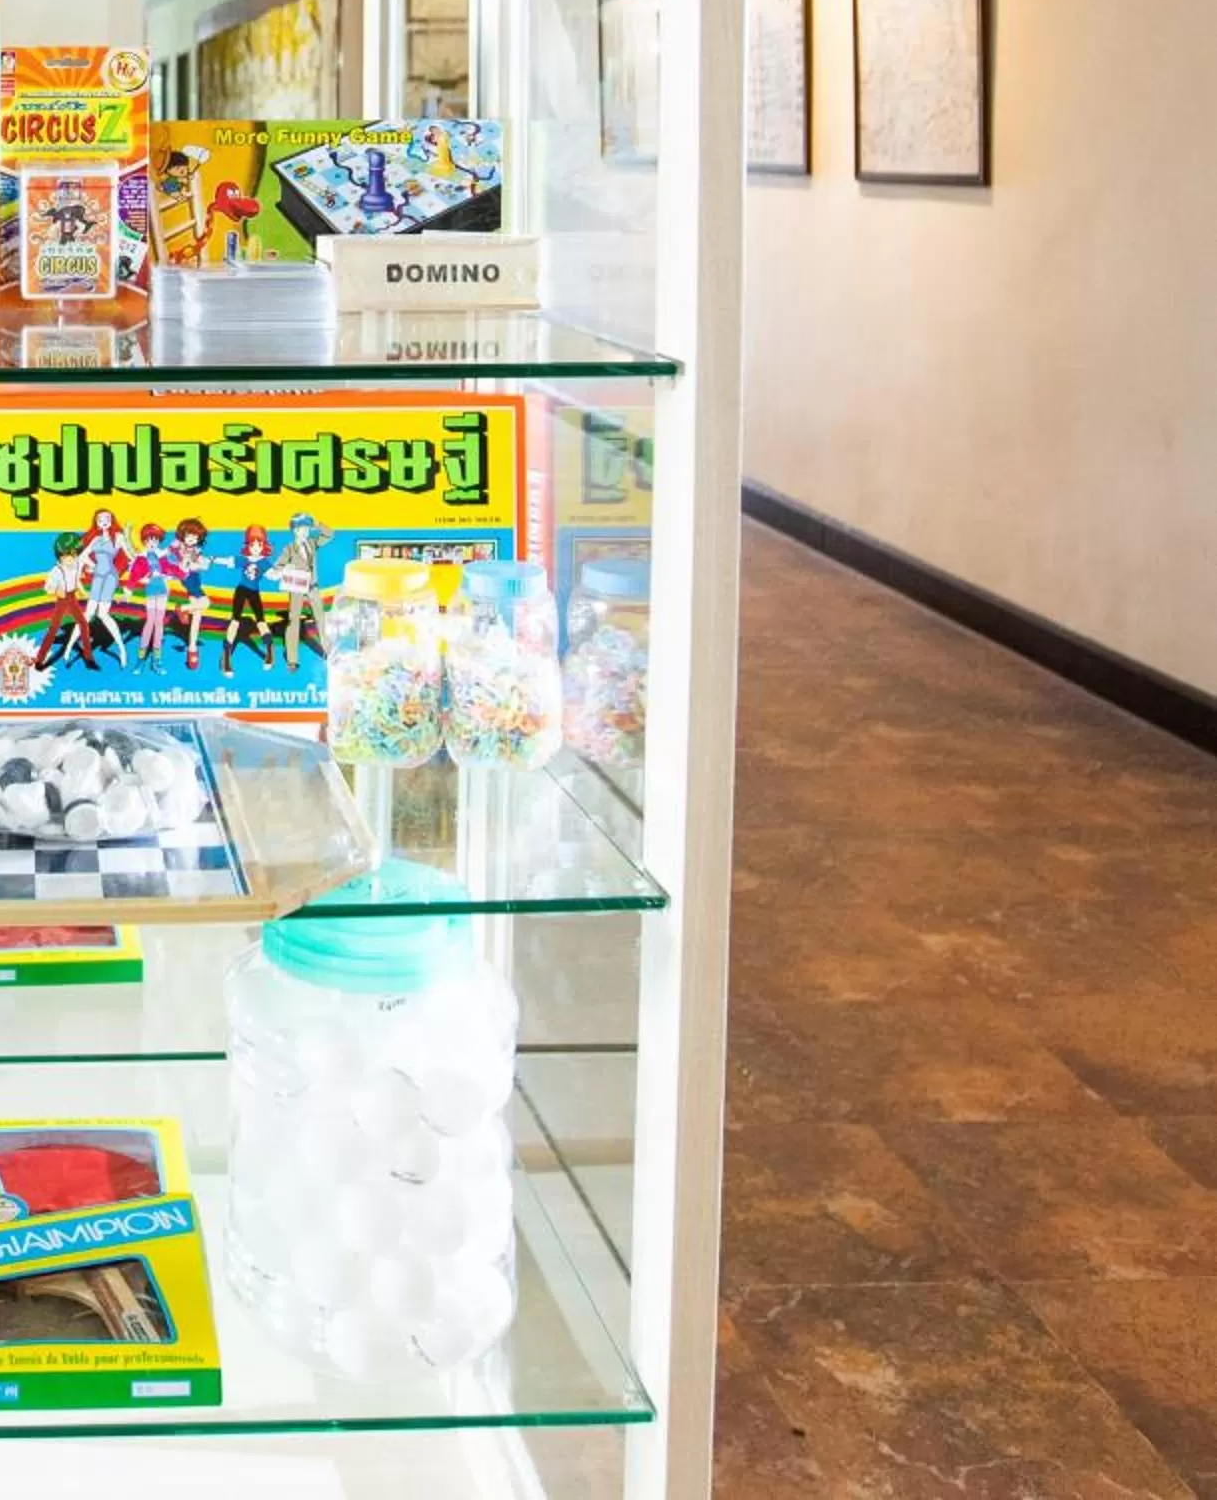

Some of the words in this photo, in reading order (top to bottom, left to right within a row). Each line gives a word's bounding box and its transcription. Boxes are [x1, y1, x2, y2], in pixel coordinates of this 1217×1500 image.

[1, 113, 96, 144] CIRCUS
[215, 129, 269, 145] More
[277, 129, 341, 147] Funny
[349, 129, 413, 145] Game
[38, 255, 98, 276] CIRCUS
[386, 263, 500, 283] DOMINO
